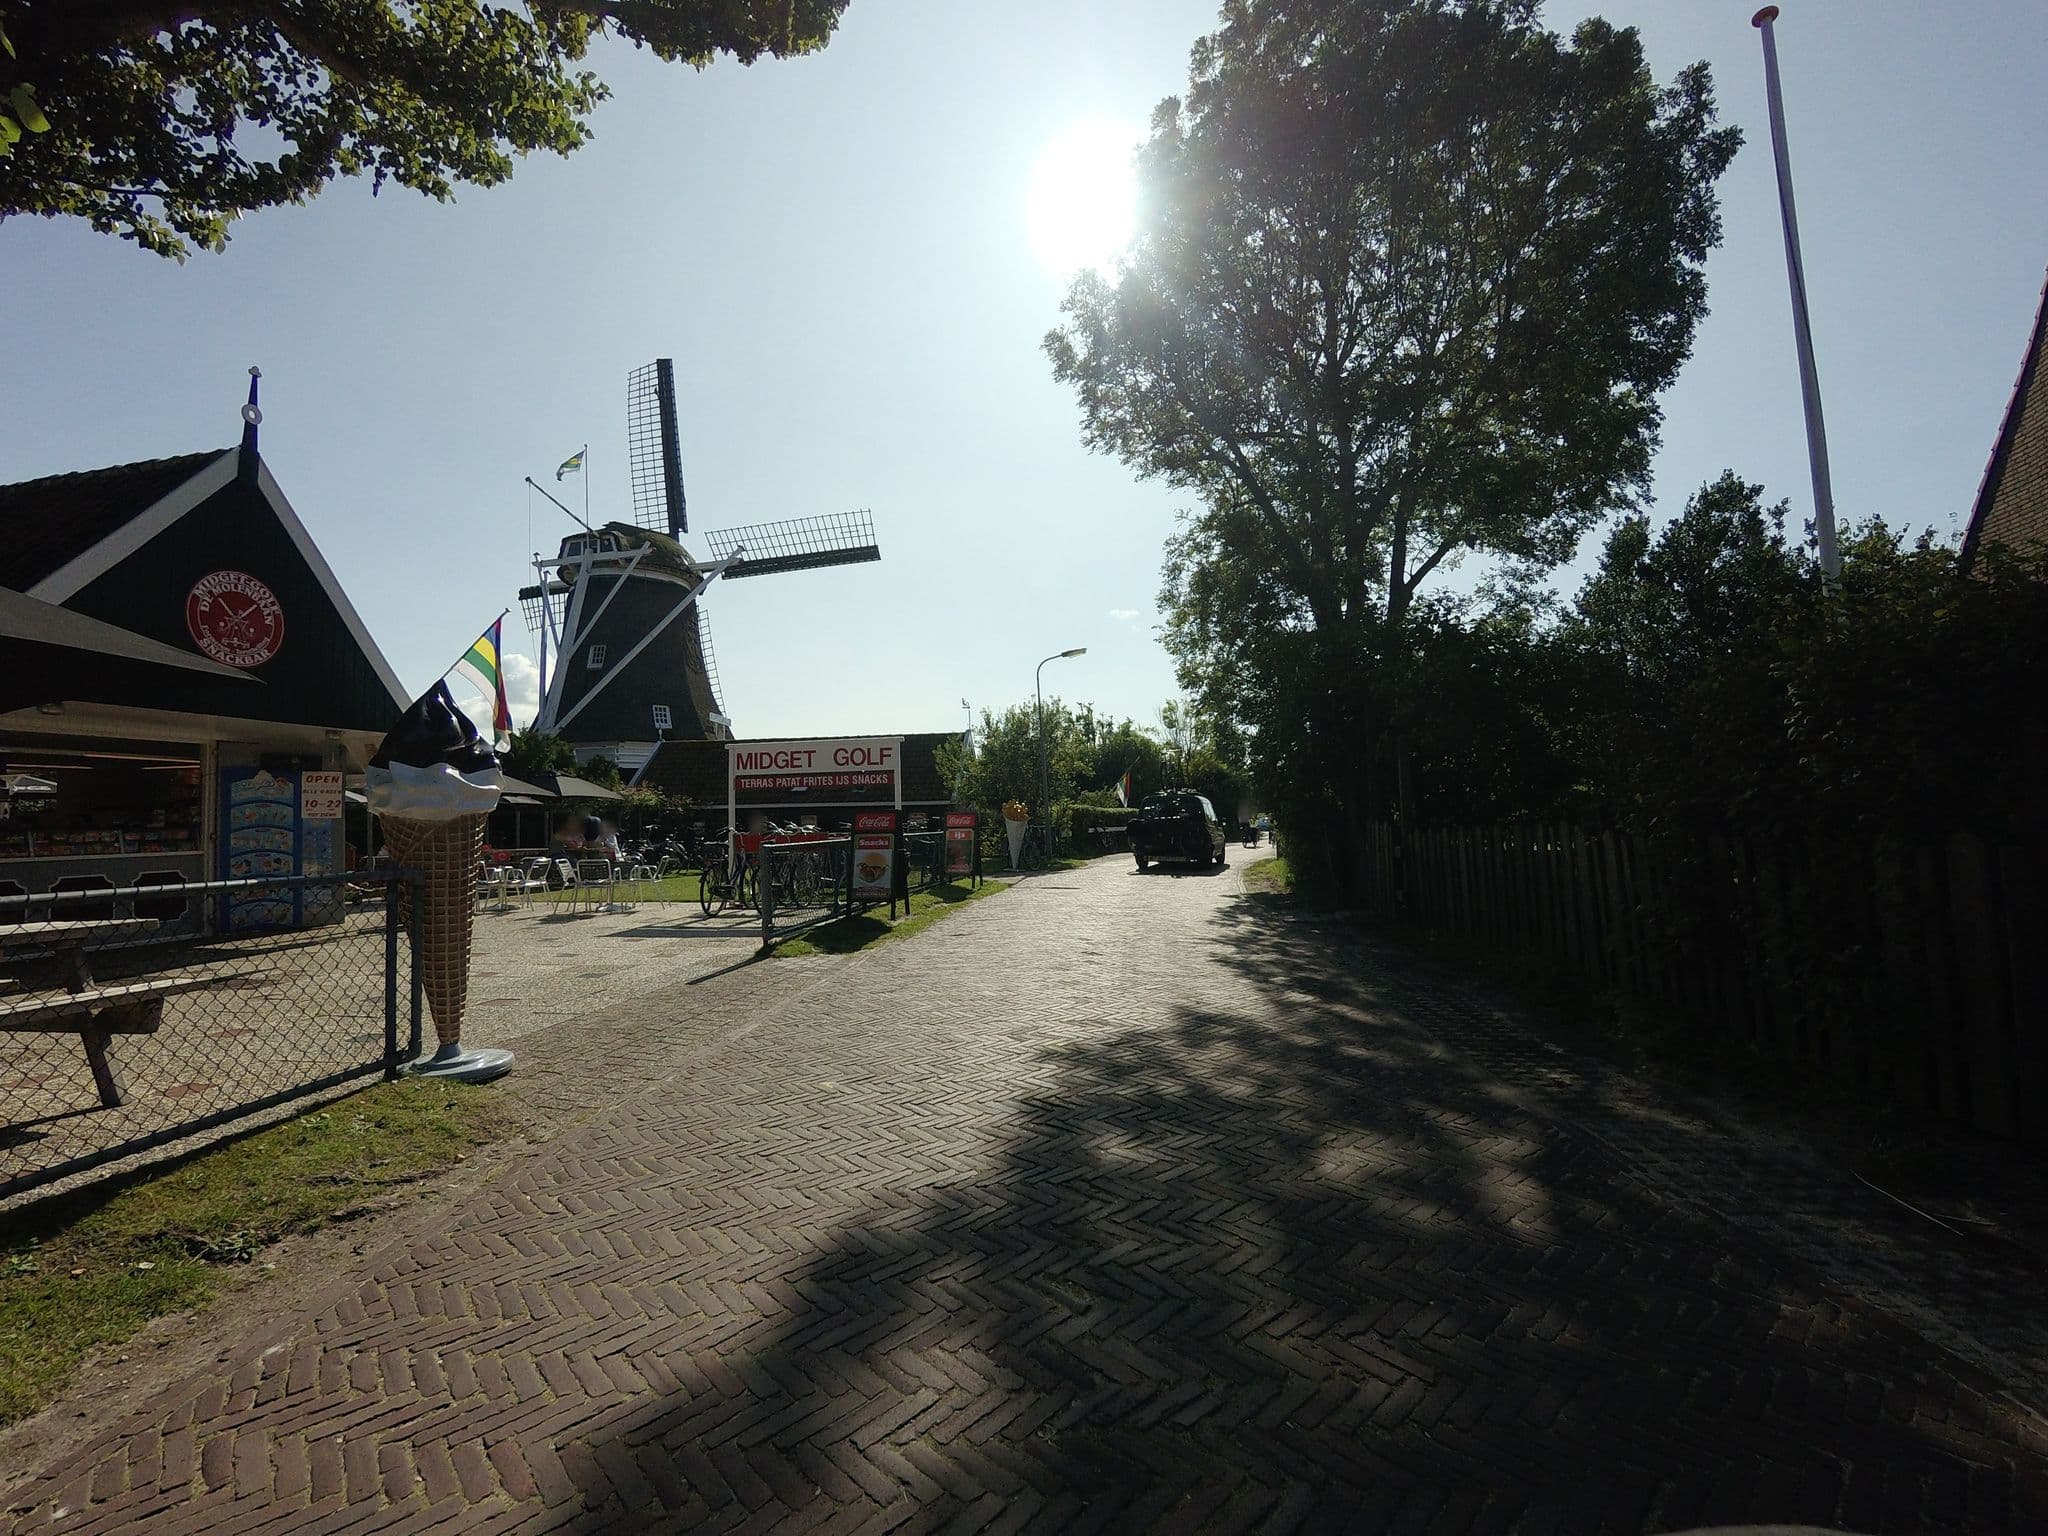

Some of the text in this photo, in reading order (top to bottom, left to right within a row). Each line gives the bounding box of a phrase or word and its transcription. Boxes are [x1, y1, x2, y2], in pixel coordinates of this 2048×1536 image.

[200, 592, 214, 613] DE
[200, 638, 271, 665] SNACKBAR
[736, 747, 893, 770] MIDGET GOLF
[306, 774, 340, 784] OPEN
[741, 773, 888, 789] TERRAS PATAT FRITES IJS SNACKS
